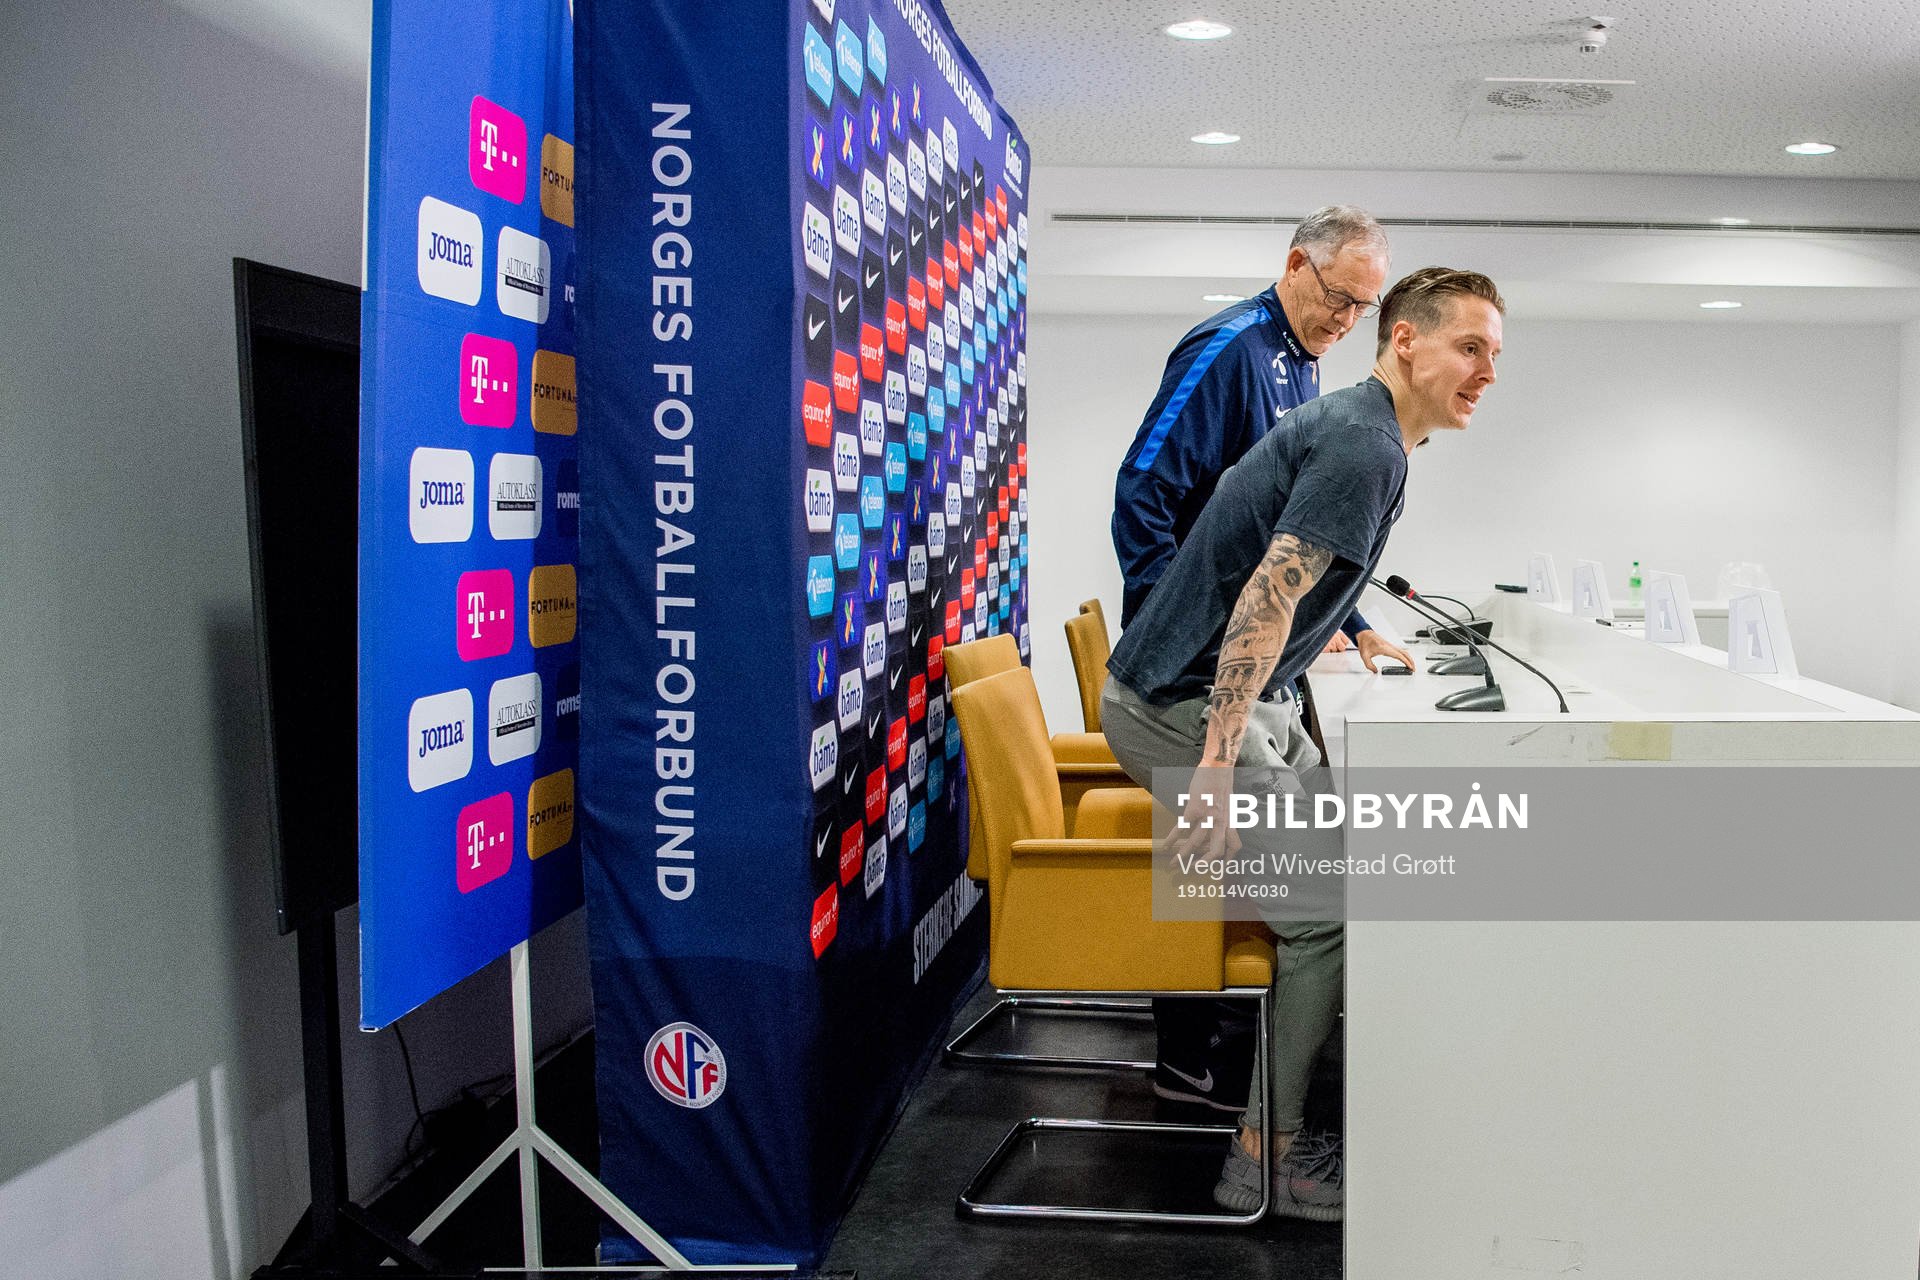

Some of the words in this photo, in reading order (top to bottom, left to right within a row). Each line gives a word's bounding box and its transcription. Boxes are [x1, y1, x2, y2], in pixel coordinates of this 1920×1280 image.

[932, 28, 993, 140] FOTBALLFORBUND
[889, 163, 905, 203] bama
[865, 180, 884, 222] bama
[650, 102, 694, 342] NORGES
[837, 197, 858, 242] bama
[807, 215, 829, 263] bama
[505, 257, 545, 284] AUTOKLASS
[861, 343, 878, 363] equinor
[834, 371, 852, 392] equinor
[888, 380, 905, 412] bama
[804, 402, 824, 424] equinor
[863, 410, 882, 442] bama
[837, 443, 857, 478] bama
[496, 482, 537, 500] AUTOKLASS
[809, 481, 830, 516] bama
[930, 521, 944, 547] bama
[910, 554, 926, 582] bama
[889, 594, 905, 622] bama
[653, 363, 696, 901] FOTBALLFORBUND
[866, 637, 884, 667] bama
[496, 700, 537, 725] AUTOKLASS
[841, 685, 860, 718] bama
[814, 741, 835, 776] bama
[890, 800, 906, 830] bama
[812, 911, 831, 940] equinor
